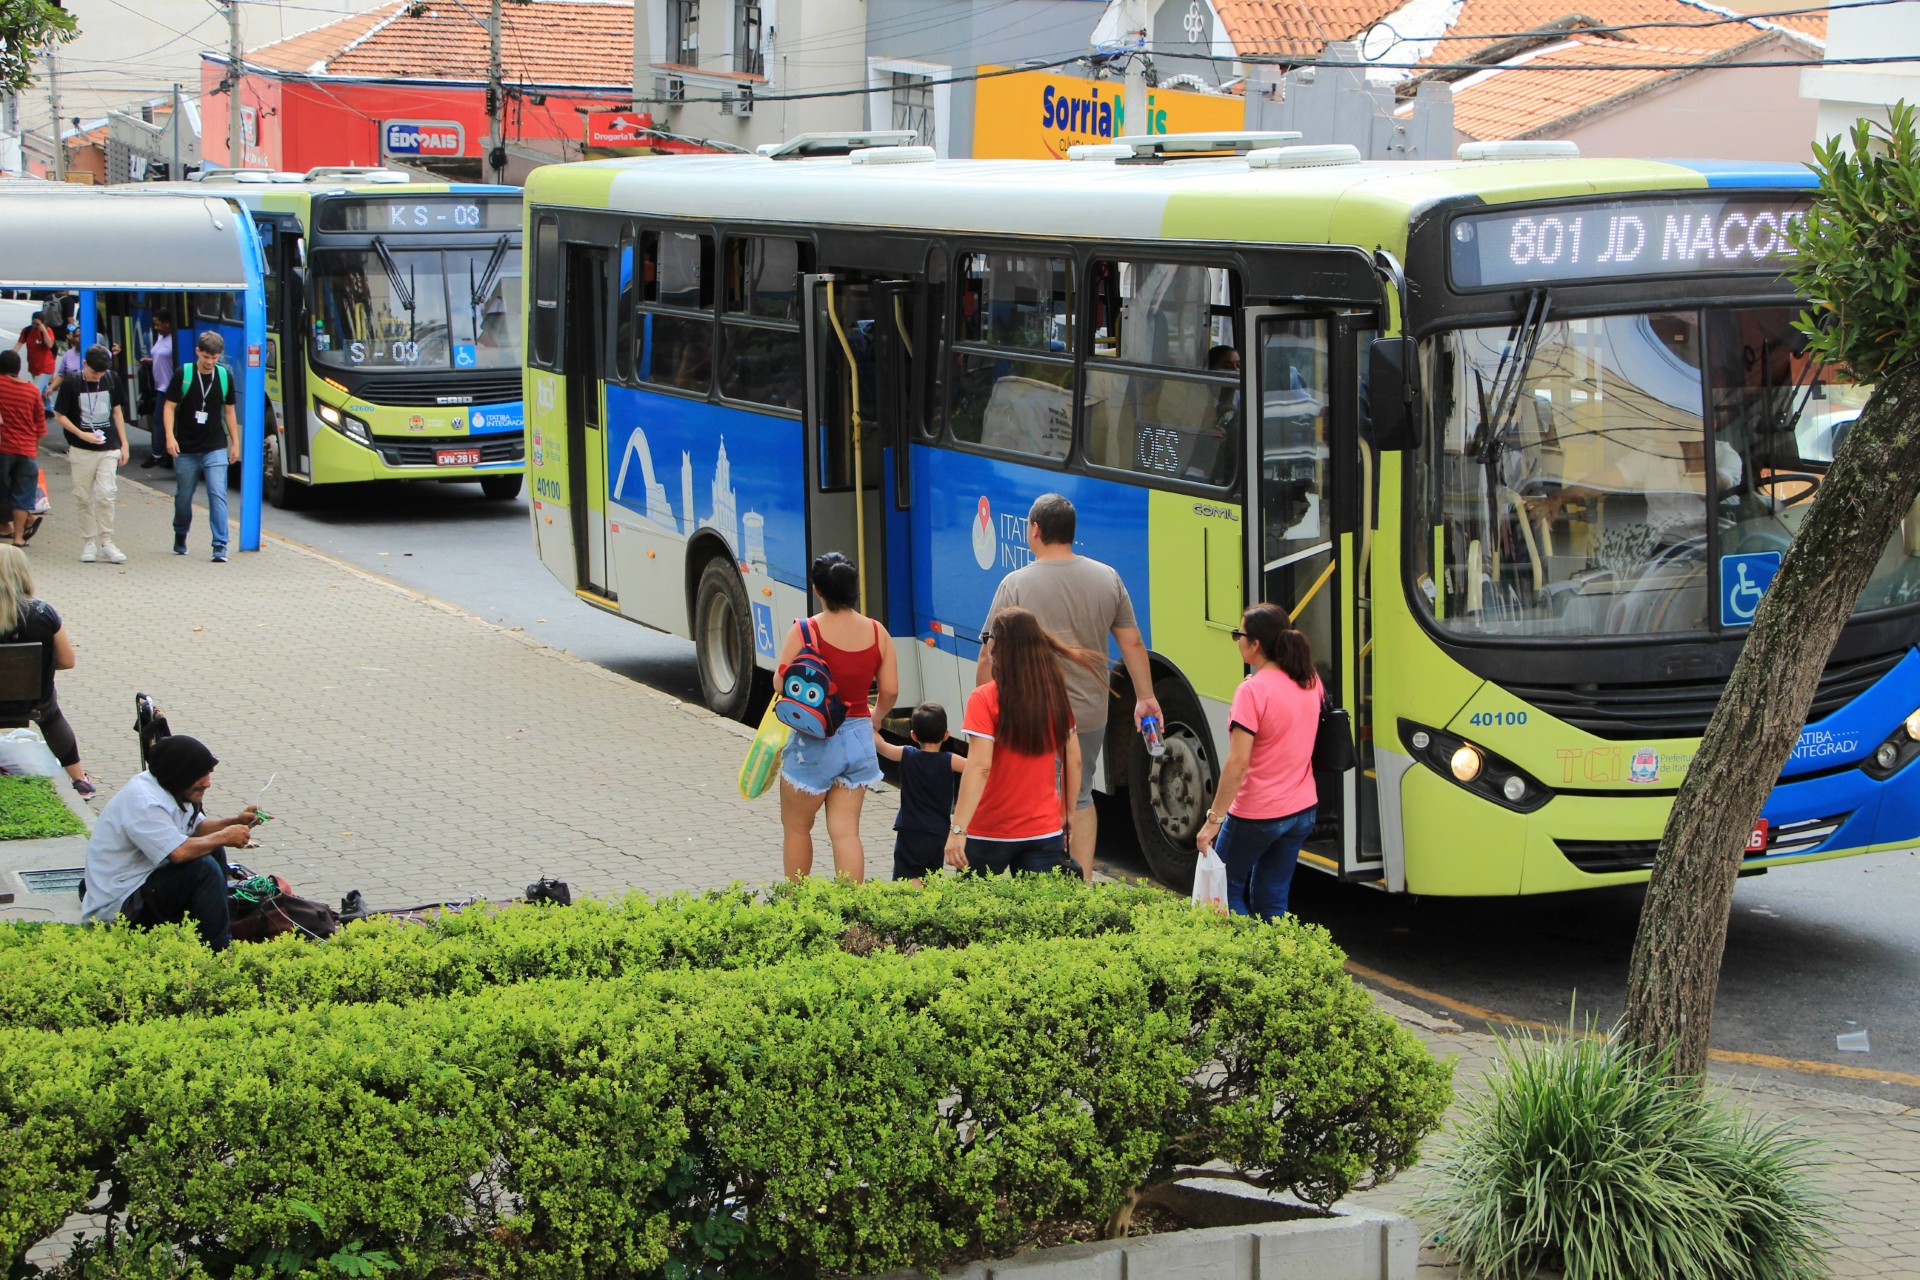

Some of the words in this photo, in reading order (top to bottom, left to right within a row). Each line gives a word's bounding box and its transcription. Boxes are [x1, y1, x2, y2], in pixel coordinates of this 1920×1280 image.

[454, 205, 480, 225] 03
[1510, 217, 1582, 265] 801
[1598, 216, 1645, 262] JD
[1662, 211, 1830, 260] NACOE
[350, 342, 365, 363] S
[537, 476, 561, 501] 40100
[1193, 503, 1239, 522] COMIL
[1000, 512, 1029, 544] ITAT
[1469, 711, 1528, 727] 40100
